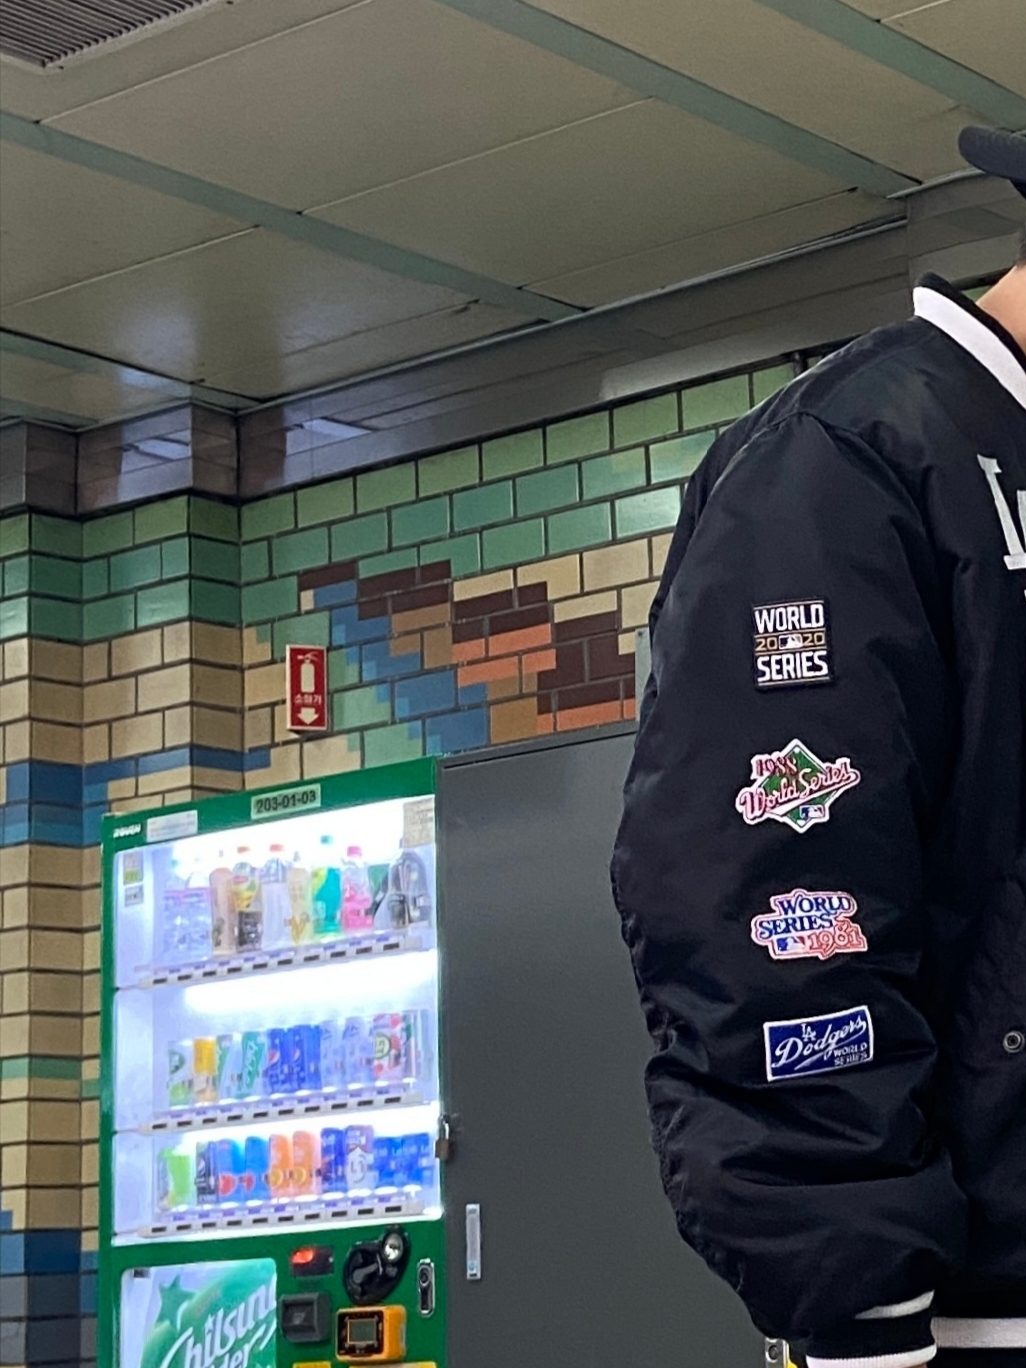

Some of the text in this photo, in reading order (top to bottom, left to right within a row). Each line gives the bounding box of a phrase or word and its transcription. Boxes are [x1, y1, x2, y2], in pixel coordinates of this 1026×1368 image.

[754, 603, 825, 634] WORLD
[756, 650, 829, 682] SERIES
[256, 789, 317, 814] 203-01-03
[739, 761, 859, 821] World Series
[777, 894, 852, 916] WORLD
[758, 913, 834, 940] SERIES
[809, 920, 862, 953] 1981
[771, 1015, 867, 1071] Dodgers
[801, 1023, 817, 1042] LA
[833, 1042, 868, 1058] WORLD
